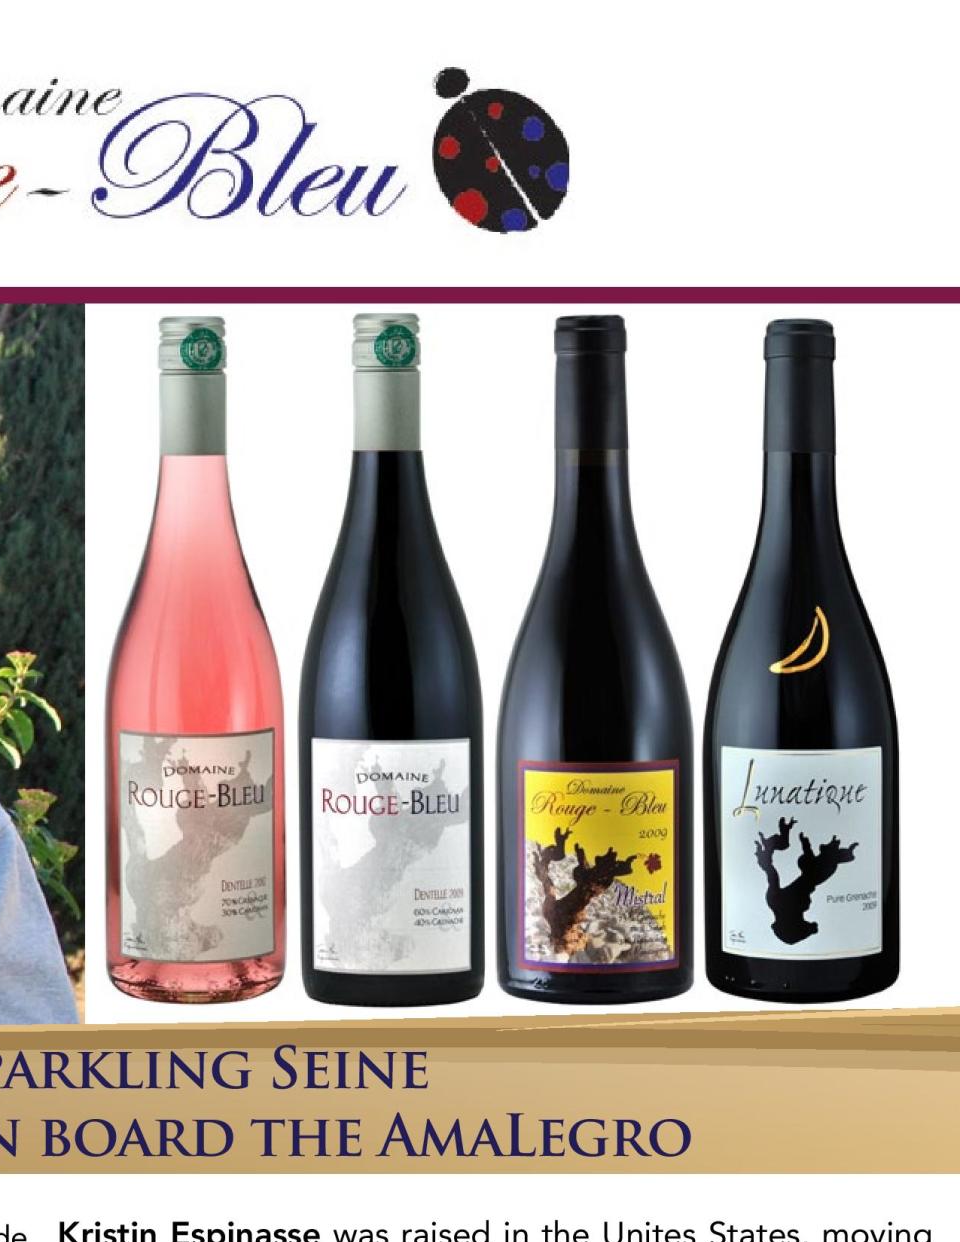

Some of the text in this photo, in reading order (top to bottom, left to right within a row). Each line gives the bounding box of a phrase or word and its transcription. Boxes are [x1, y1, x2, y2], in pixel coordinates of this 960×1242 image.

[163, 765, 235, 777] DOMAINE
[356, 772, 429, 784] DOMAINE
[565, 779, 625, 795] Domaine
[638, 828, 668, 840] 2009
[272, 1044, 429, 1090] SEINE
